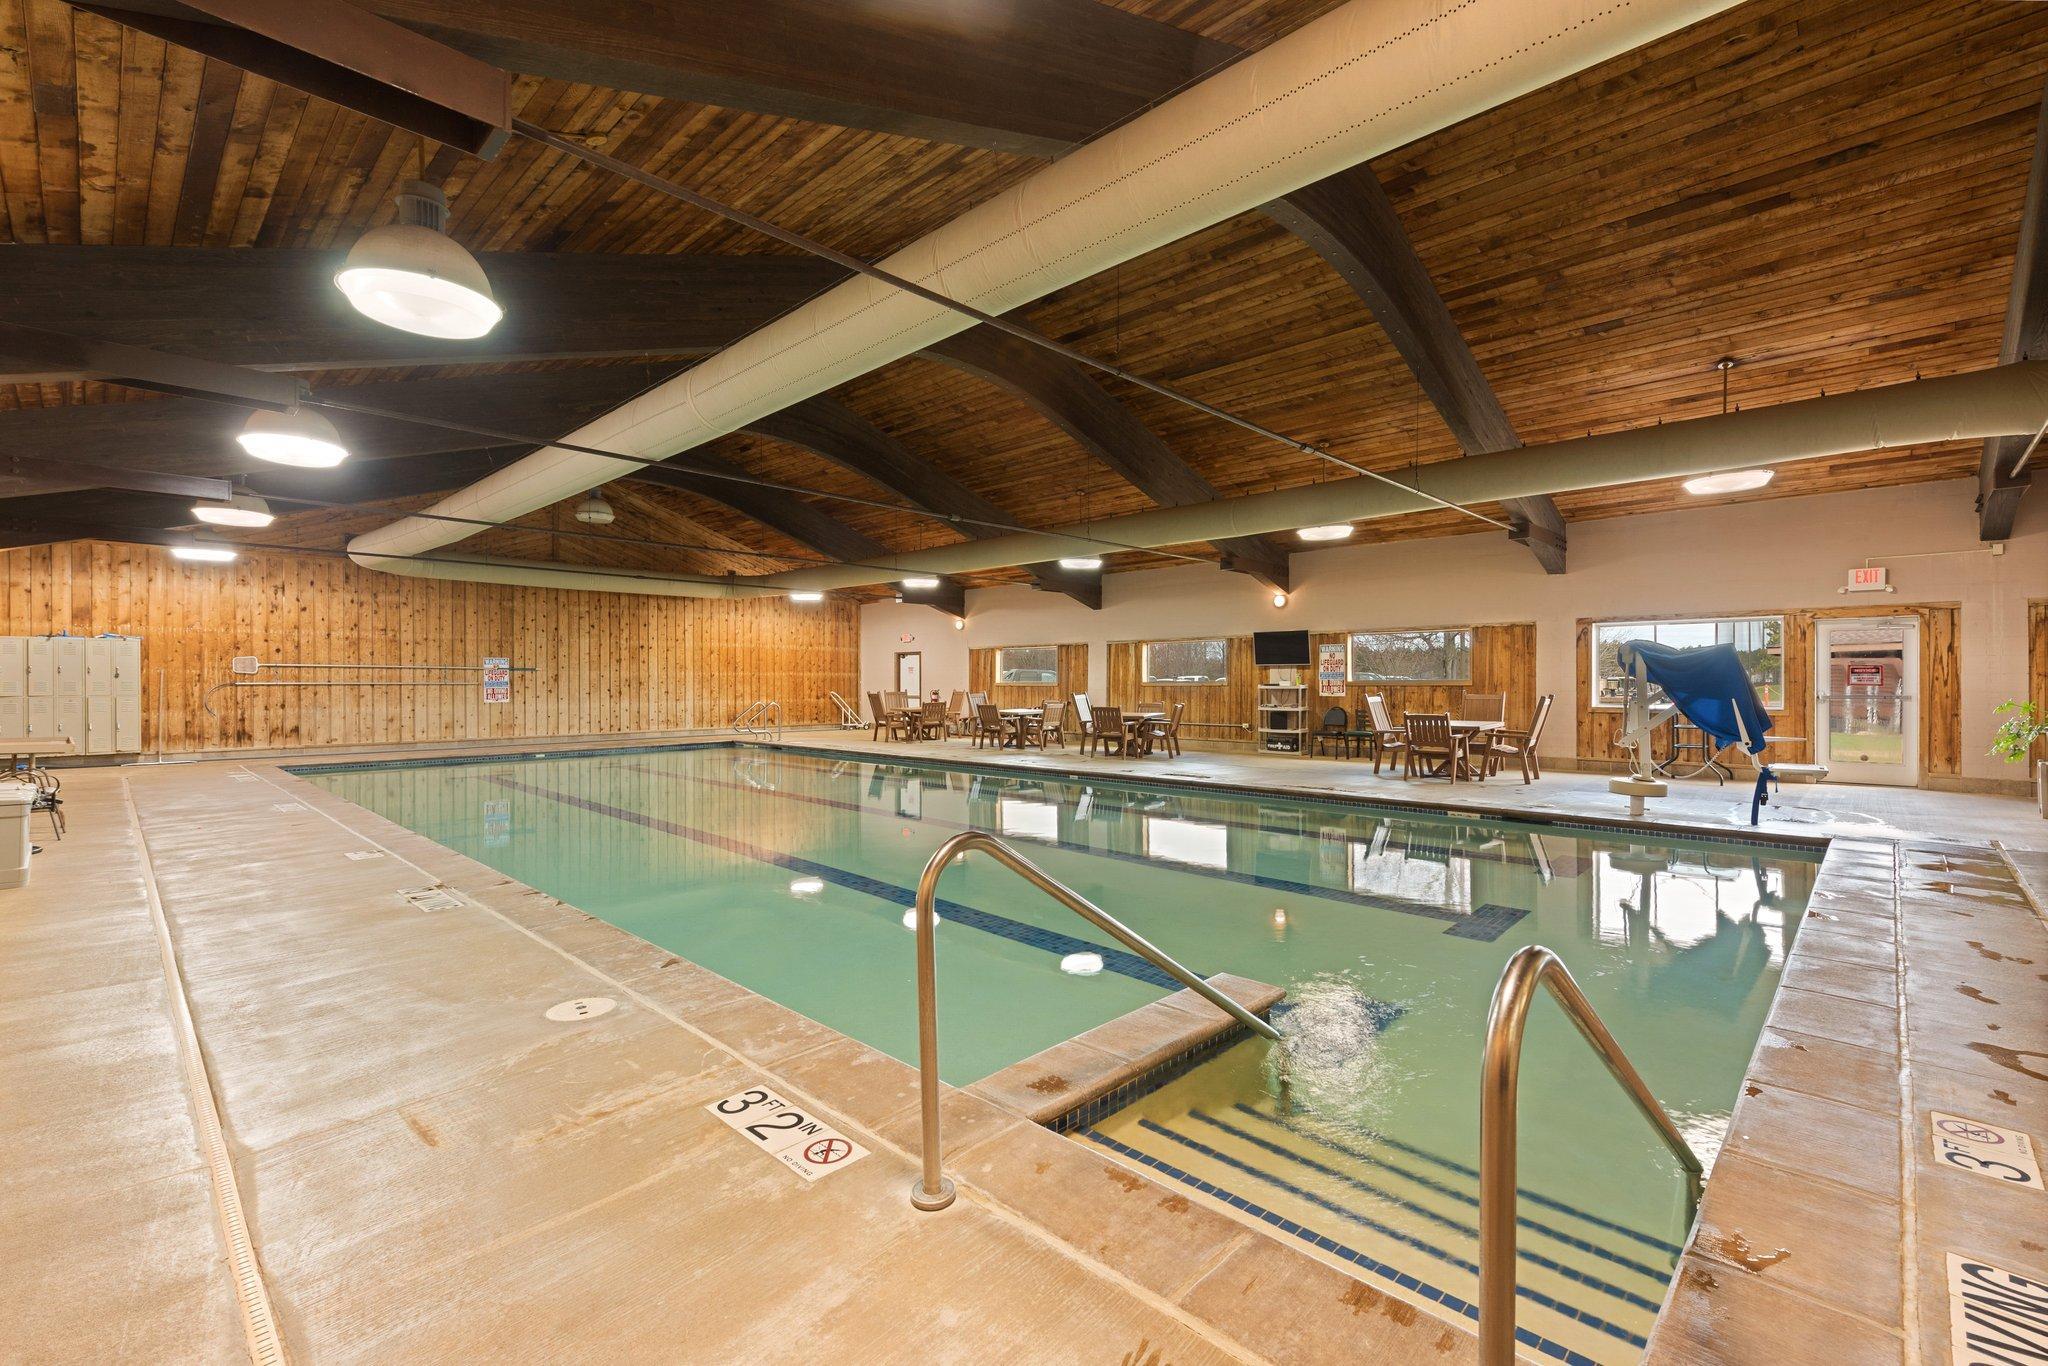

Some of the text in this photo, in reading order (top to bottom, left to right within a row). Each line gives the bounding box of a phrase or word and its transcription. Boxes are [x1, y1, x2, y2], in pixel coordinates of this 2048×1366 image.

[1855, 569, 1880, 583] EXIT
[716, 1090, 823, 1142] 3 FT 2 IN
[782, 1154, 814, 1176] NO DIVING
[1944, 1151, 2032, 1183] 3
[1960, 1263, 2048, 1366] IVING
